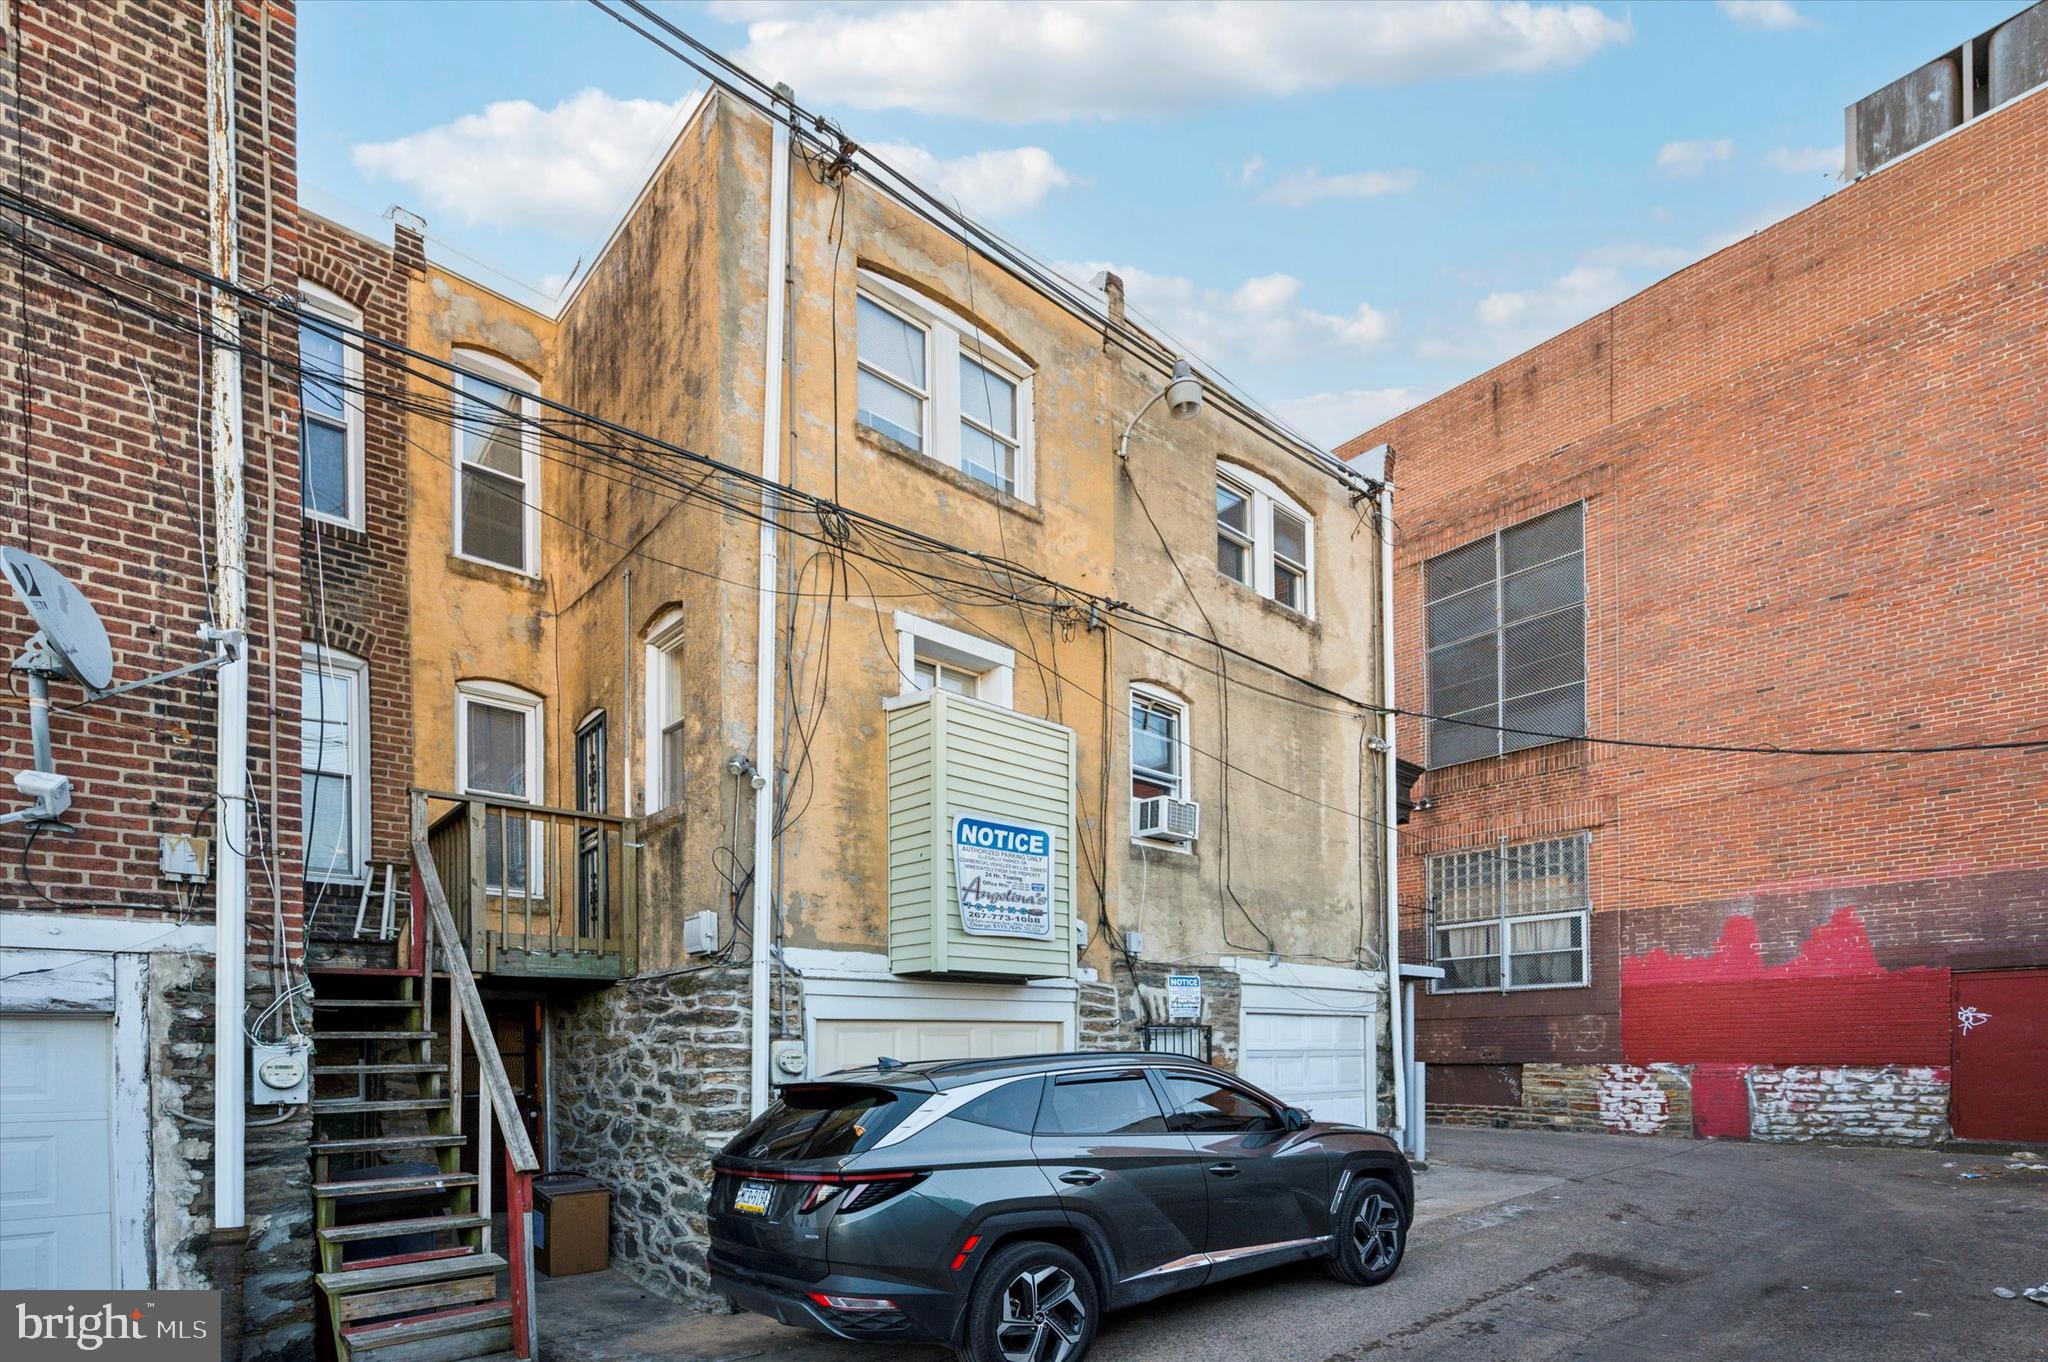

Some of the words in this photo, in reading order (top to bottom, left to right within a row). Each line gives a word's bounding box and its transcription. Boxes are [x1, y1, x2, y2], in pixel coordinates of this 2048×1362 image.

[961, 824, 1044, 853] NOTICE
[962, 845, 999, 856] AUTHORIZED
[1000, 851, 1025, 860] PARKING
[1003, 874, 1022, 882] Towing
